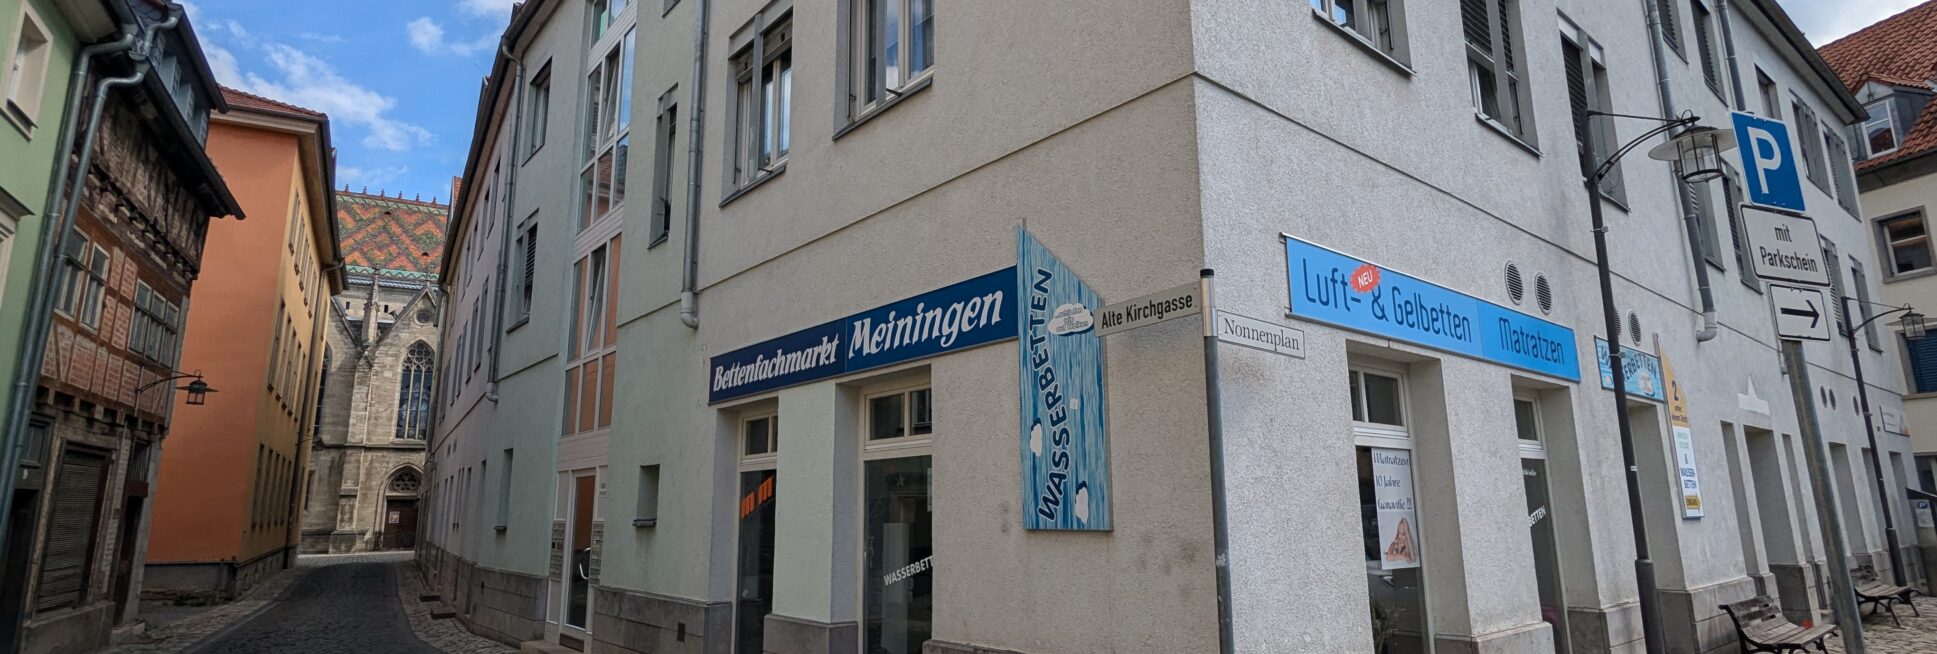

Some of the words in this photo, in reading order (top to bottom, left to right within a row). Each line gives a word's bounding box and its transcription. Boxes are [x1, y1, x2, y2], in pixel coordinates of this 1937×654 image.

[1747, 127, 1782, 194] P
[1774, 223, 1792, 243] mit
[1760, 246, 1818, 273] Parkschein
[1358, 269, 1373, 289] NEU
[1101, 311, 1123, 330] Alte
[1126, 294, 1193, 324] Kirchgasse
[1302, 257, 1361, 313] Luft-
[1371, 283, 1389, 322] &
[1391, 285, 1473, 343] Gelbetten
[1498, 316, 1565, 367] Matratzen
[713, 333, 839, 392] Bettenfachmarkt
[848, 289, 1004, 360] Meiningen
[1224, 317, 1300, 351] Nonnenplan
[1029, 267, 1071, 522] WASSERBETTEN
[1671, 380, 1679, 402] 2
[1373, 452, 1409, 466] Matratzen
[1375, 475, 1383, 487] 10
[1377, 497, 1406, 510] Garantie
